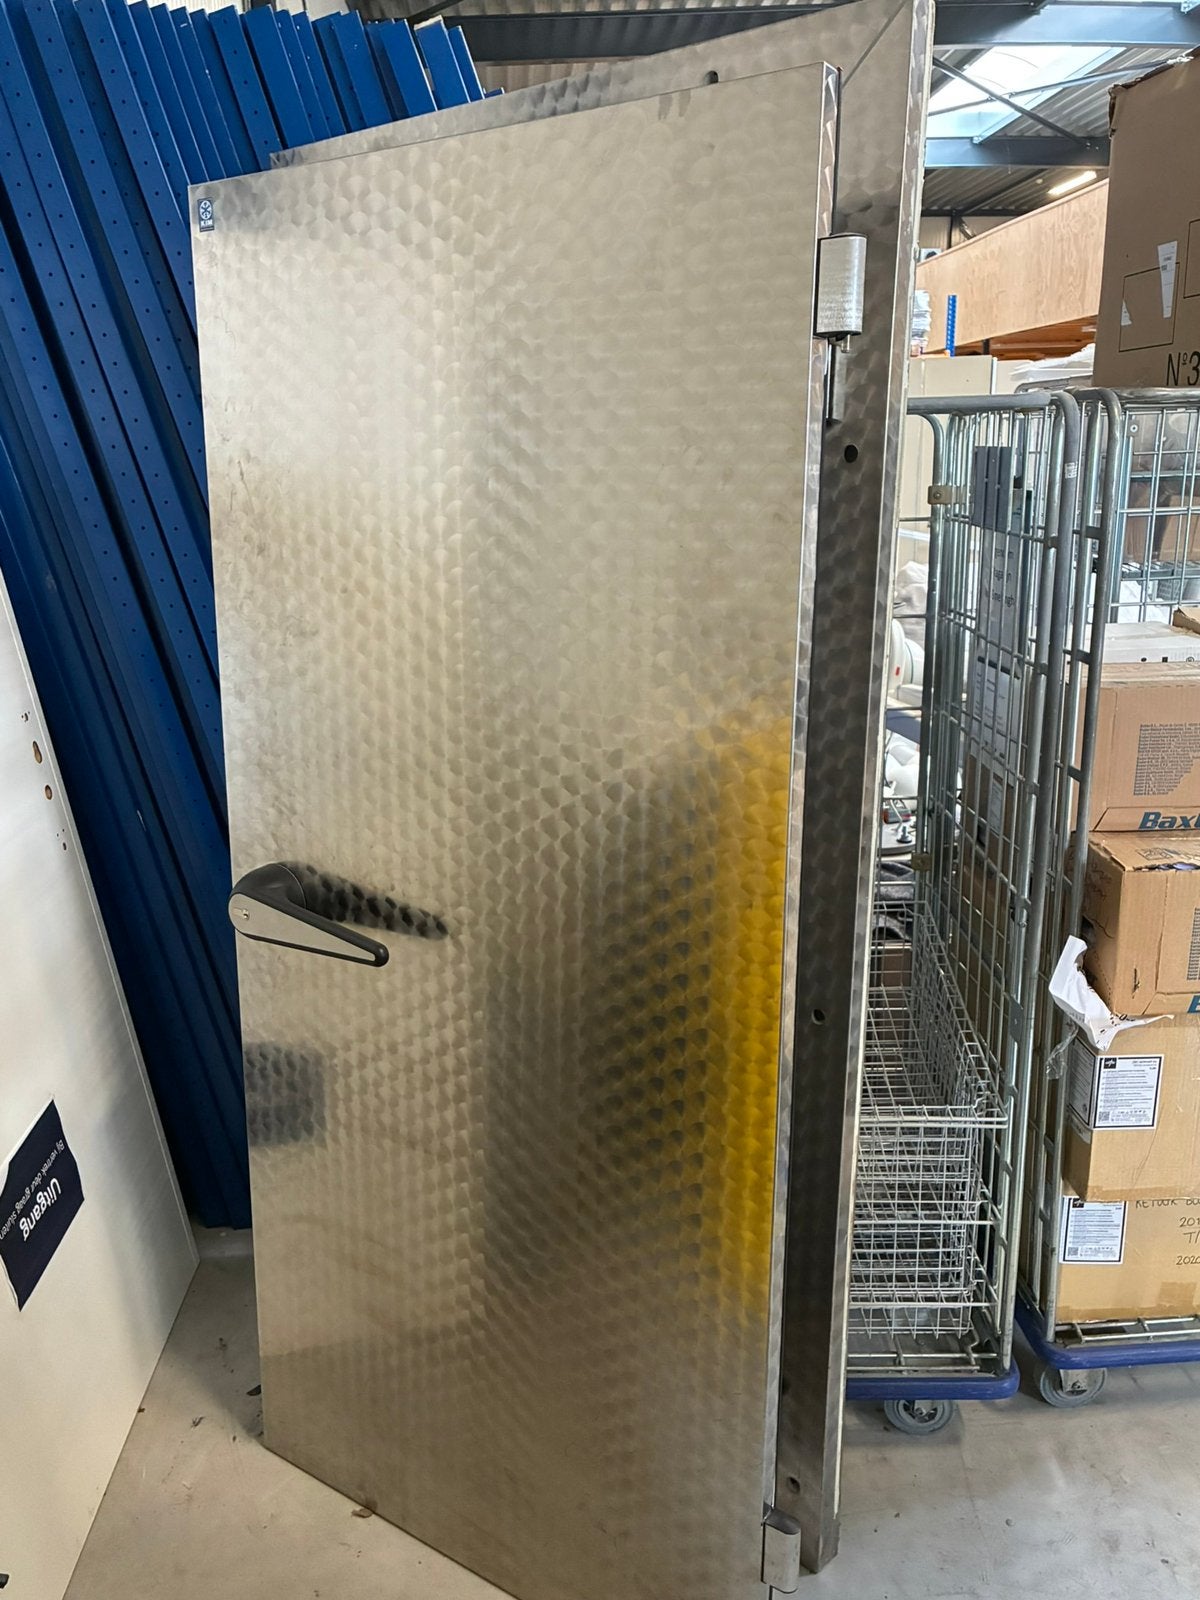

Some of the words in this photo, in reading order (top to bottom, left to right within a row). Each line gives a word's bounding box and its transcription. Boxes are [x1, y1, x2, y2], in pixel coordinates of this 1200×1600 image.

[41, 1149, 58, 1176] vertrek
[30, 1172, 42, 1193] deur
[15, 1186, 31, 1214] graag
[19, 1177, 62, 1241] Uitgang
